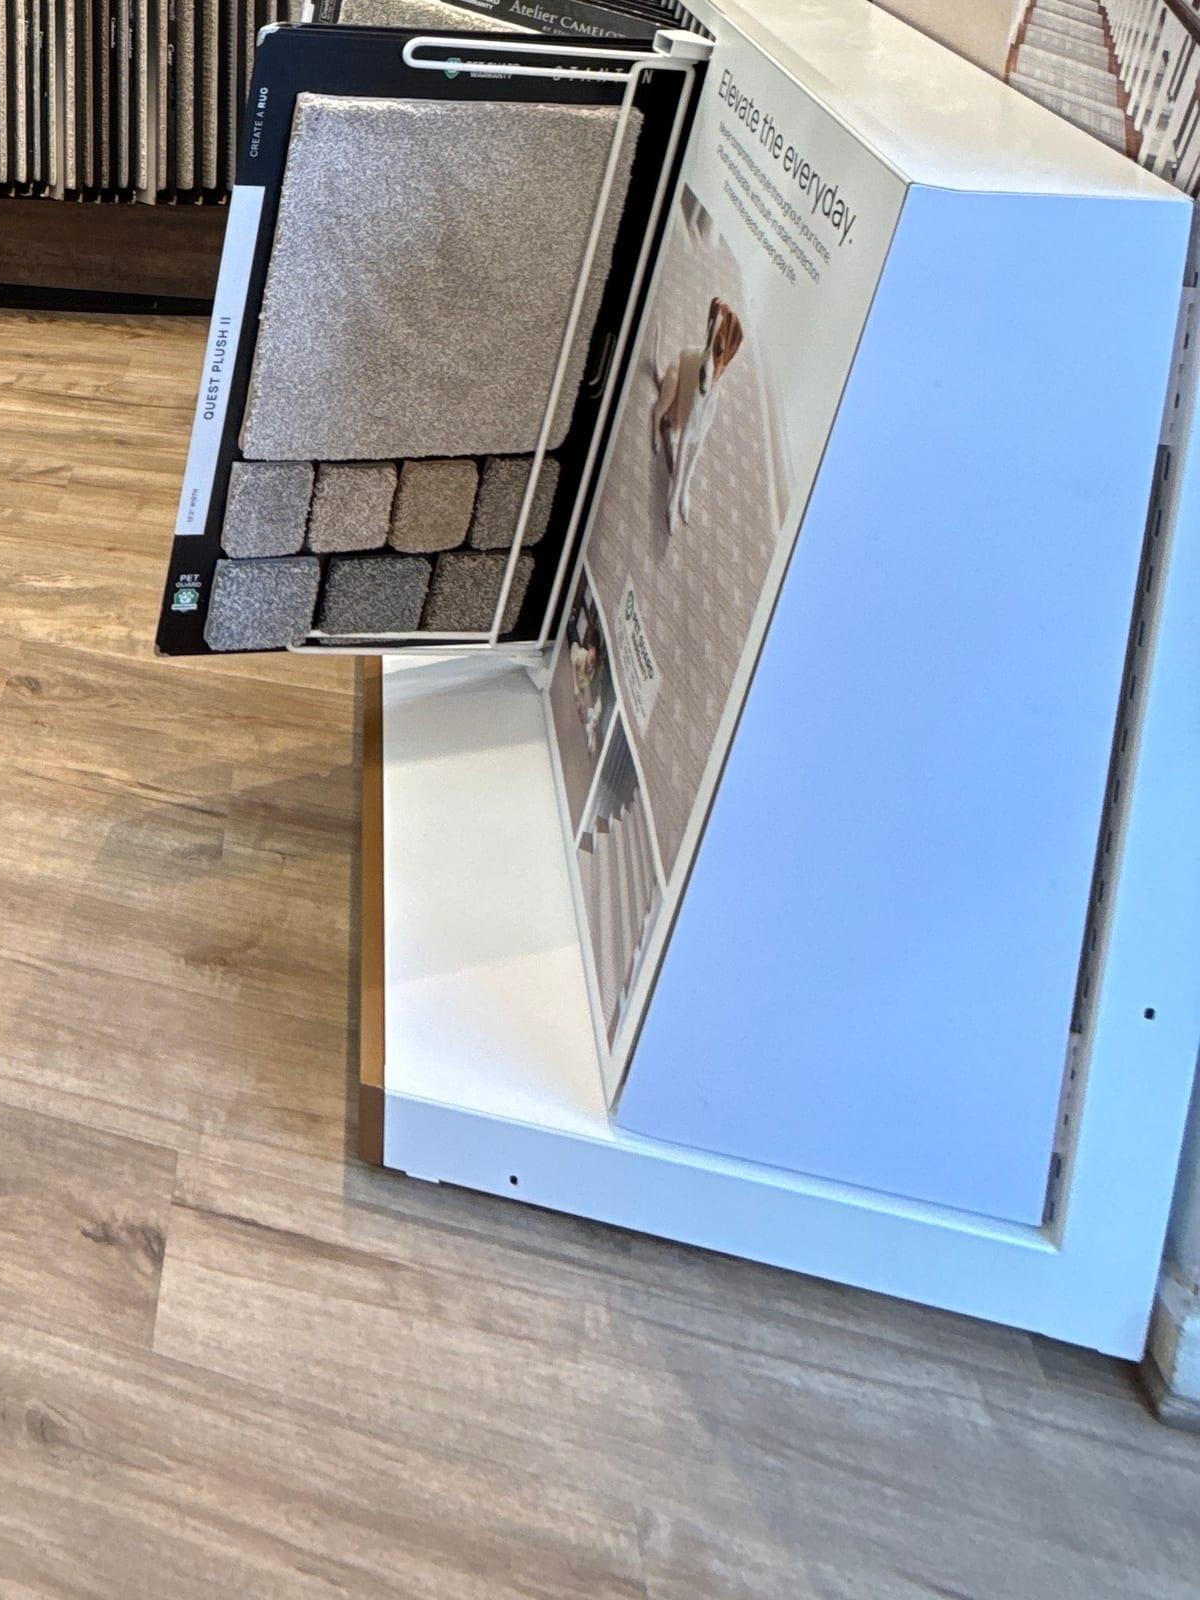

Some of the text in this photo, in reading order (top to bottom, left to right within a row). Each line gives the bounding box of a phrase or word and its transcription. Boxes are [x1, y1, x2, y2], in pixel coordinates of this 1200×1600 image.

[249, 119, 264, 158] CREATE
[257, 87, 269, 109] RUG
[718, 69, 760, 134] Elevate
[759, 115, 784, 160] the
[783, 145, 857, 247] everyday.
[203, 378, 219, 421] QUEST
[211, 331, 227, 373] PLUSH
